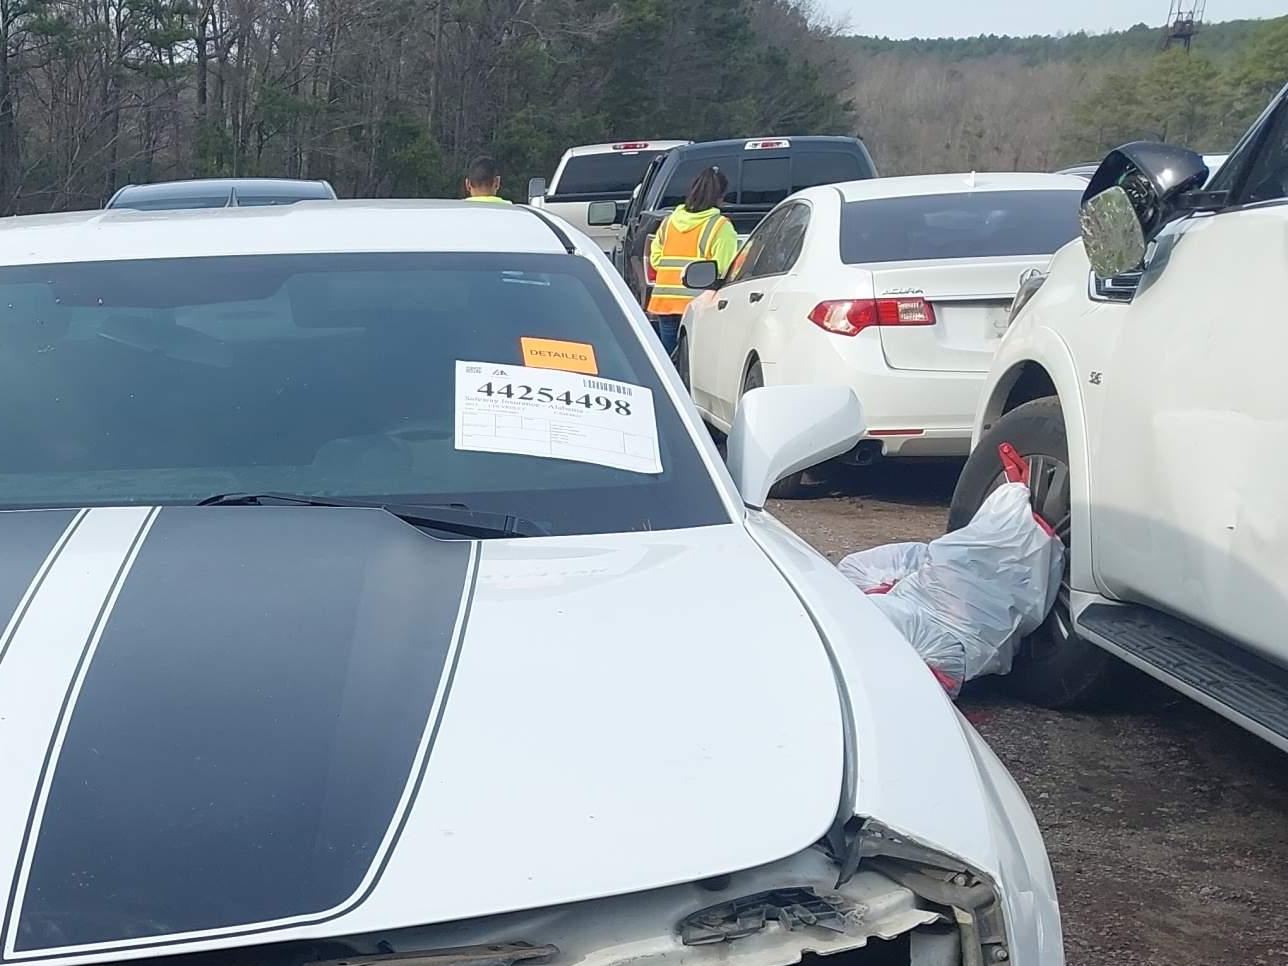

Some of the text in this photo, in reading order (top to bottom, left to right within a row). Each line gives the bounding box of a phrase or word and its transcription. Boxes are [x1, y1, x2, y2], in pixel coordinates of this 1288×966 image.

[882, 287, 924, 295] ACURA
[529, 349, 588, 361] DETAILED
[476, 381, 632, 417] 44254498
